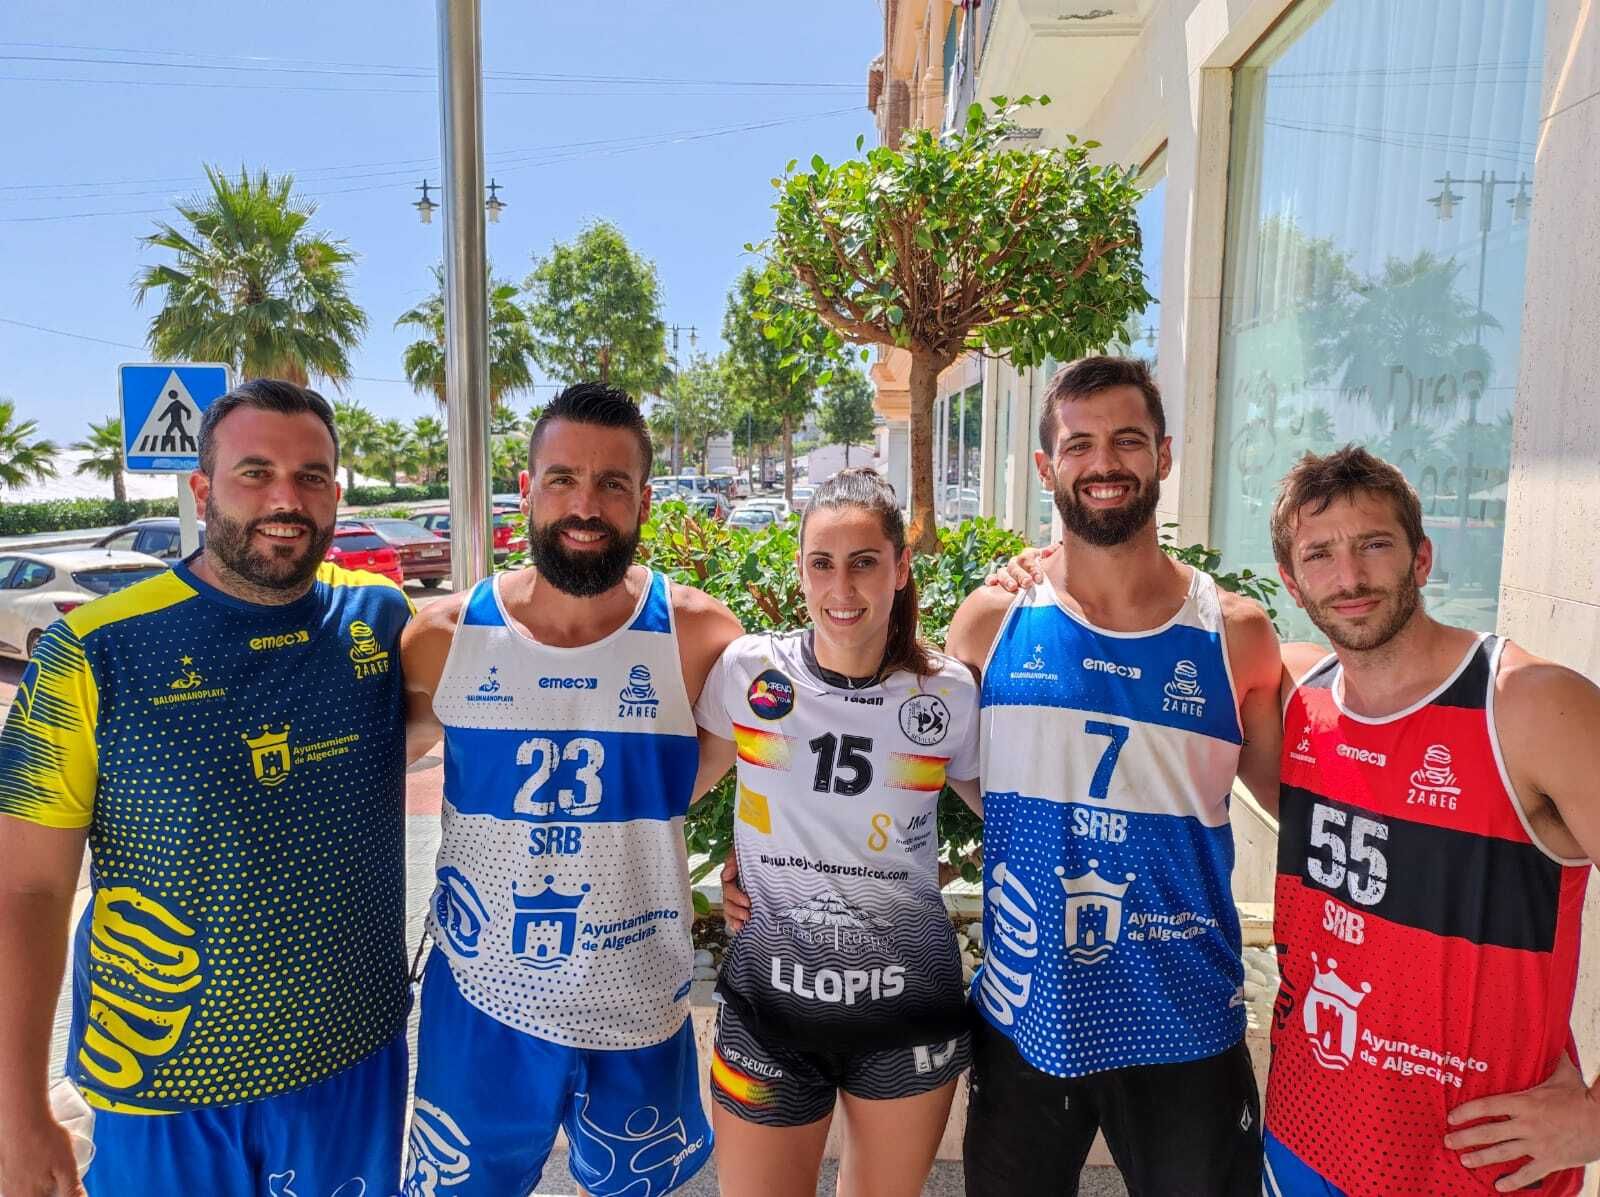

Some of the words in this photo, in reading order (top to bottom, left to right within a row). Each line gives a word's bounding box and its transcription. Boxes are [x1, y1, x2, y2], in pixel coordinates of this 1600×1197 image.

[1082, 657, 1130, 678] emec
[539, 677, 586, 690] emec
[153, 687, 226, 706] BALONMANOPLAYA
[618, 705, 657, 718] 2AREG
[1162, 698, 1205, 718] 2AREG
[293, 733, 360, 757] Ayuntamiento
[294, 755, 305, 765] de
[306, 746, 350, 764] Algeciras
[1336, 743, 1379, 765] emec
[809, 731, 874, 796] 15
[1084, 720, 1130, 800] 7
[513, 737, 605, 816] 23
[1406, 789, 1457, 810] 2AREG
[1071, 807, 1128, 843] SRB
[528, 826, 582, 856] SRB
[1307, 803, 1389, 906] 55
[760, 854, 909, 881] www.tejdosrusticos.com
[582, 908, 679, 937] Ayuntamiento
[1322, 900, 1365, 944] SRB
[581, 940, 598, 951] de
[1128, 930, 1145, 941] de
[771, 956, 906, 1005] LLOPIS
[741, 1056, 783, 1078] SEVILLA
[1360, 1050, 1377, 1066] de
